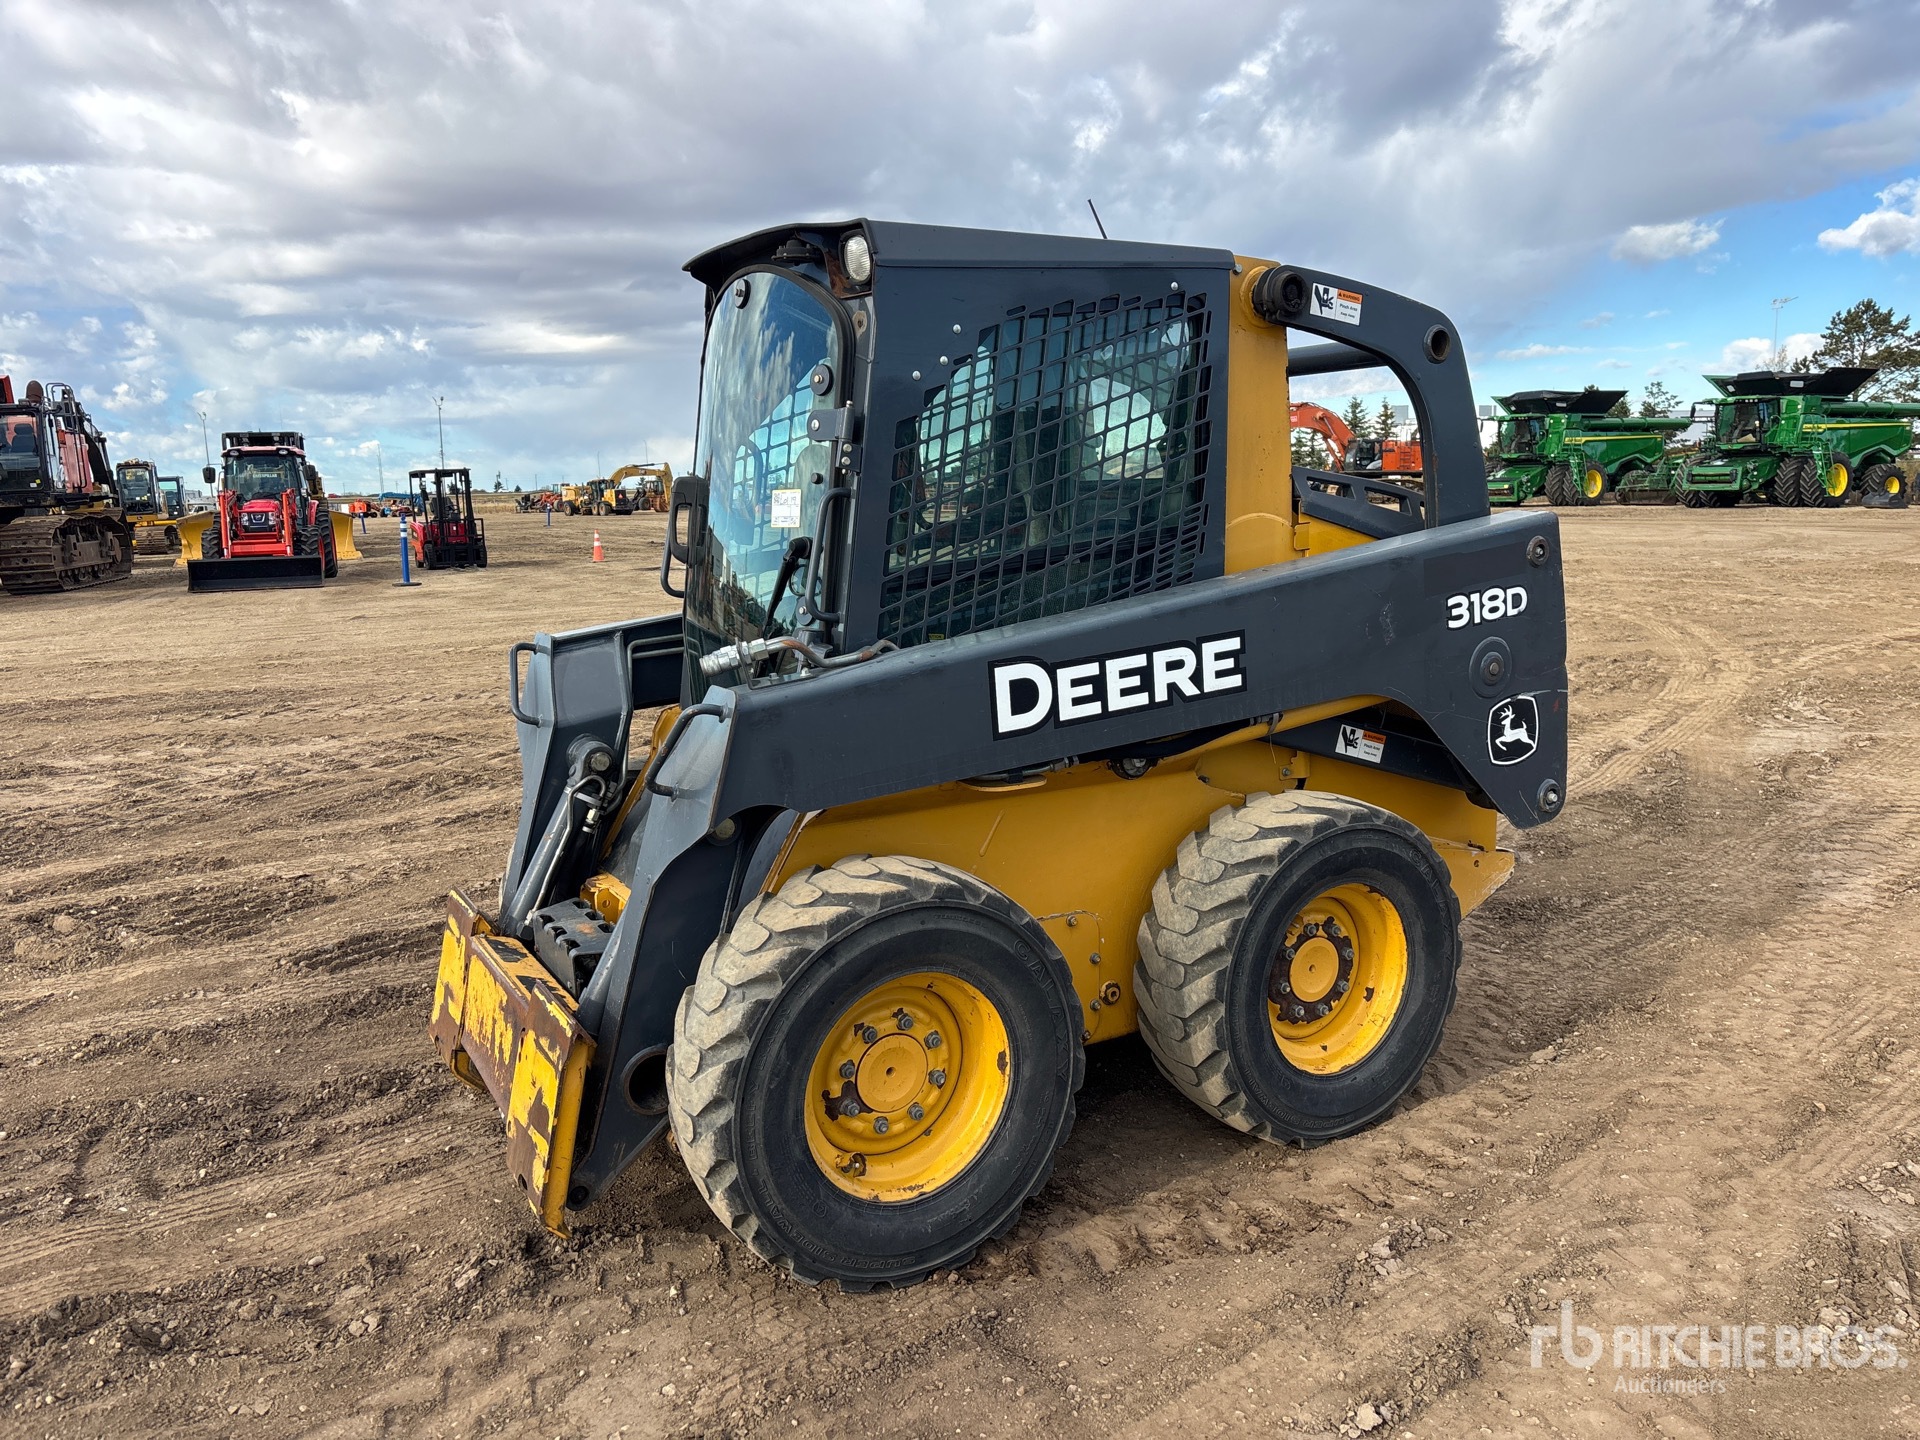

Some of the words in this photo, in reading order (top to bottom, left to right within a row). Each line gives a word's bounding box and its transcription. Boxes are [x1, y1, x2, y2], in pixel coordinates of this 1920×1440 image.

[1342, 293, 1360, 301] WARNING
[1447, 586, 1528, 629] 318D
[994, 636, 1243, 734] DEERE
[1014, 939, 1069, 1082] GALAXY
[757, 1180, 838, 1263] SIDEWALL
[838, 1255, 917, 1270] SUPER
